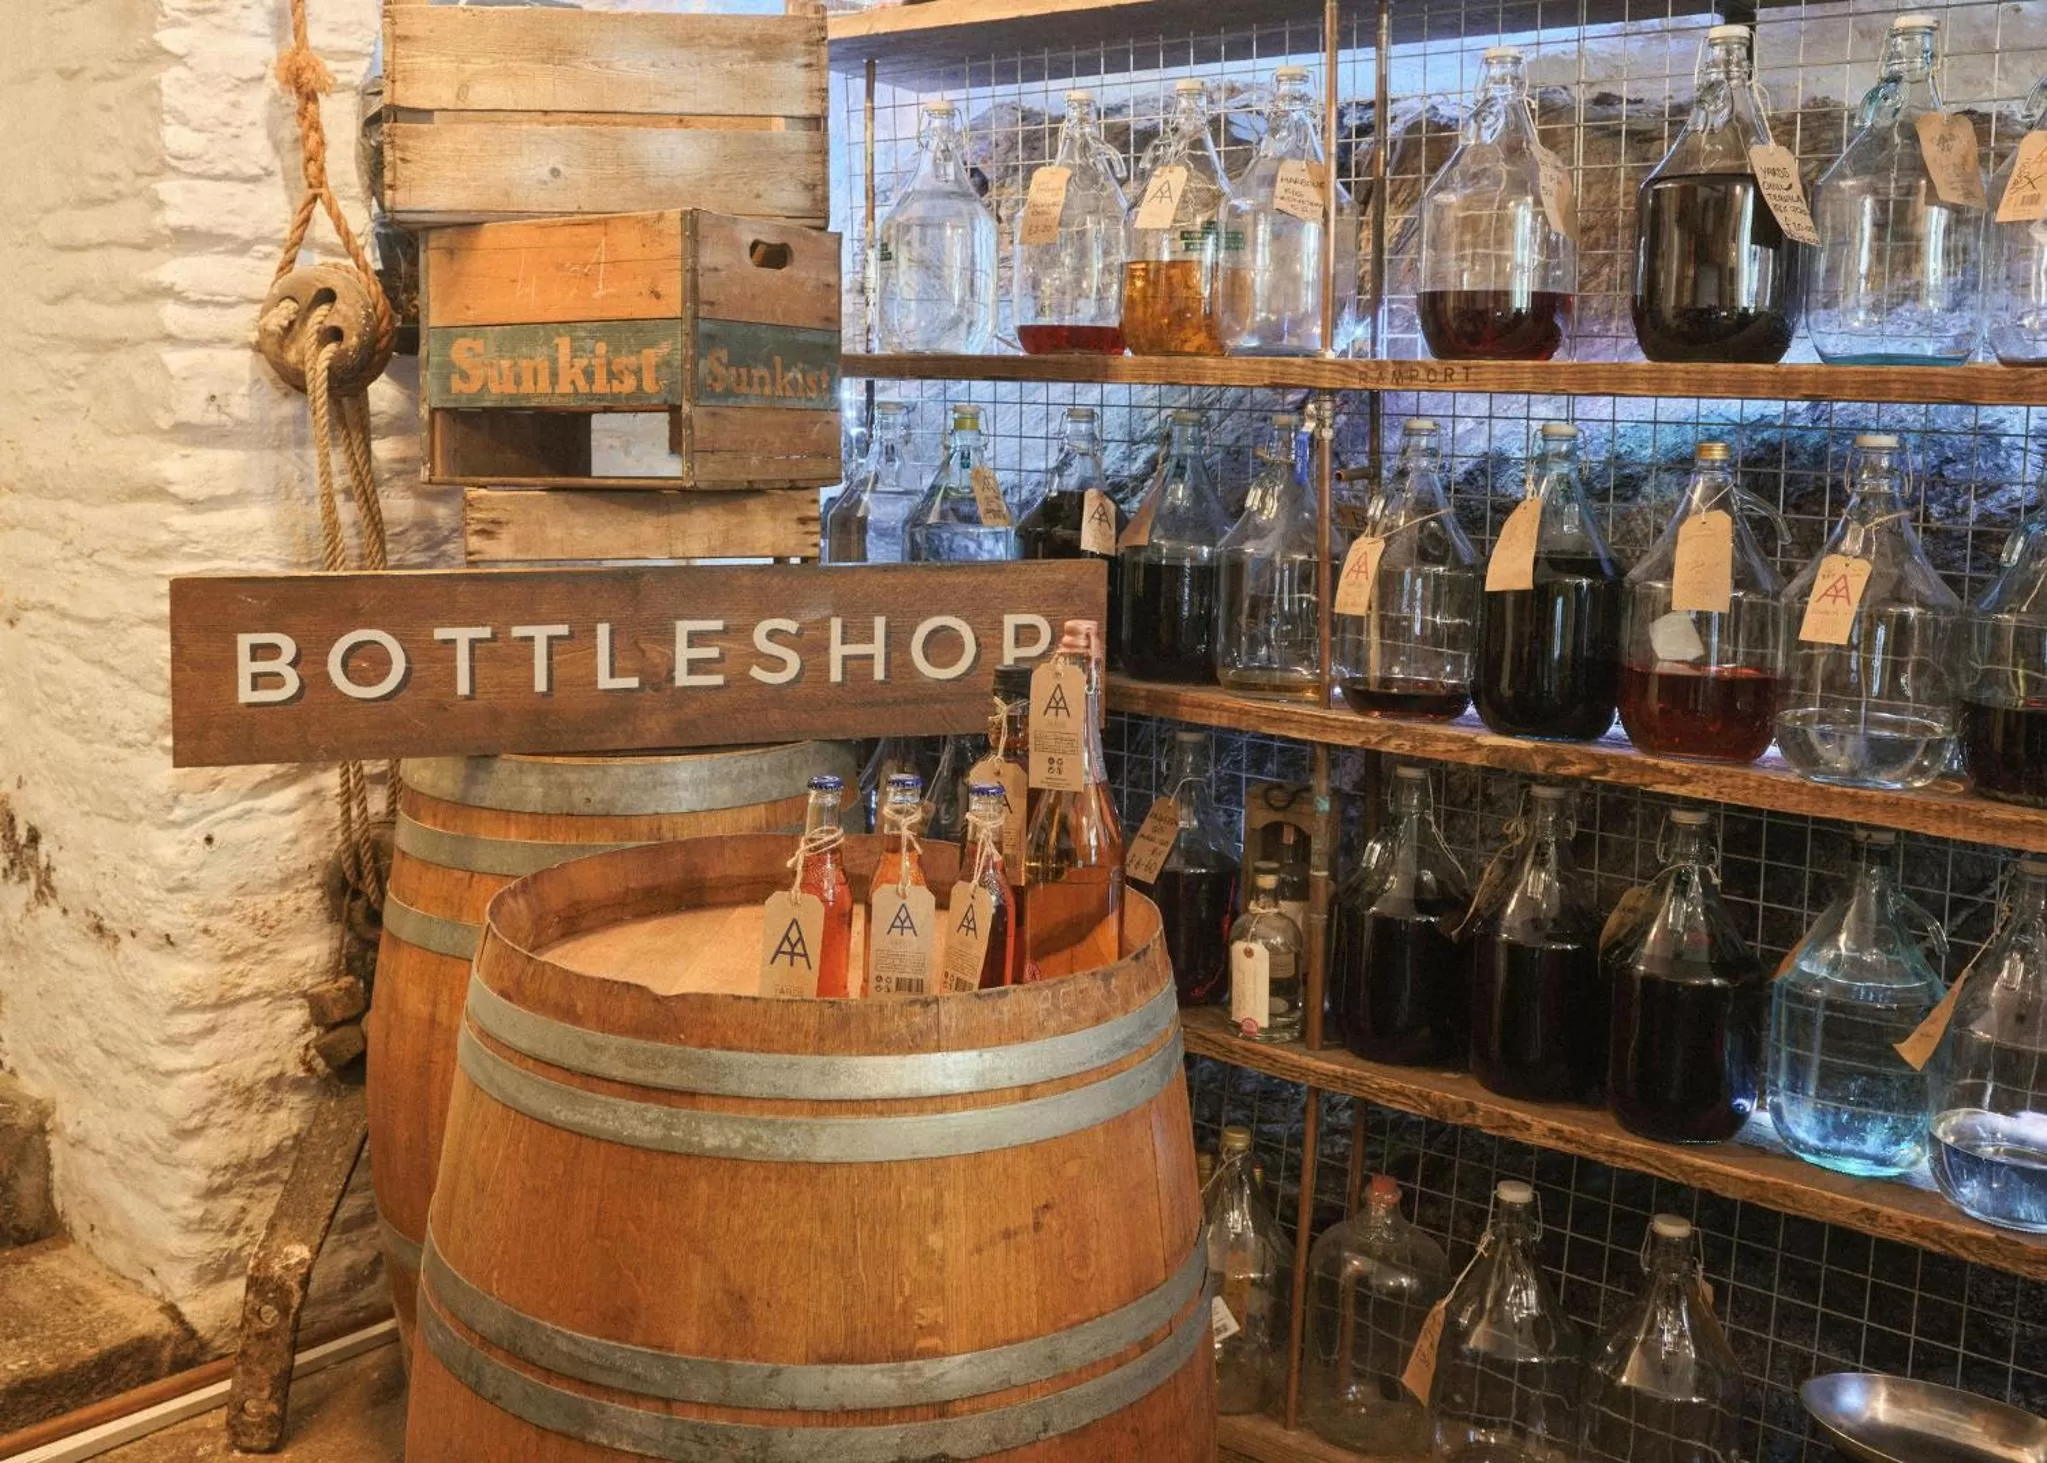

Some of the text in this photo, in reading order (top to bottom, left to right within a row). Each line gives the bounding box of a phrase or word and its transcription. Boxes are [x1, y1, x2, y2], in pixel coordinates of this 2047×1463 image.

[450, 336, 671, 395] Sunkist
[705, 347, 831, 398] Sunkist
[237, 613, 1053, 704] BOTTLESHOP
